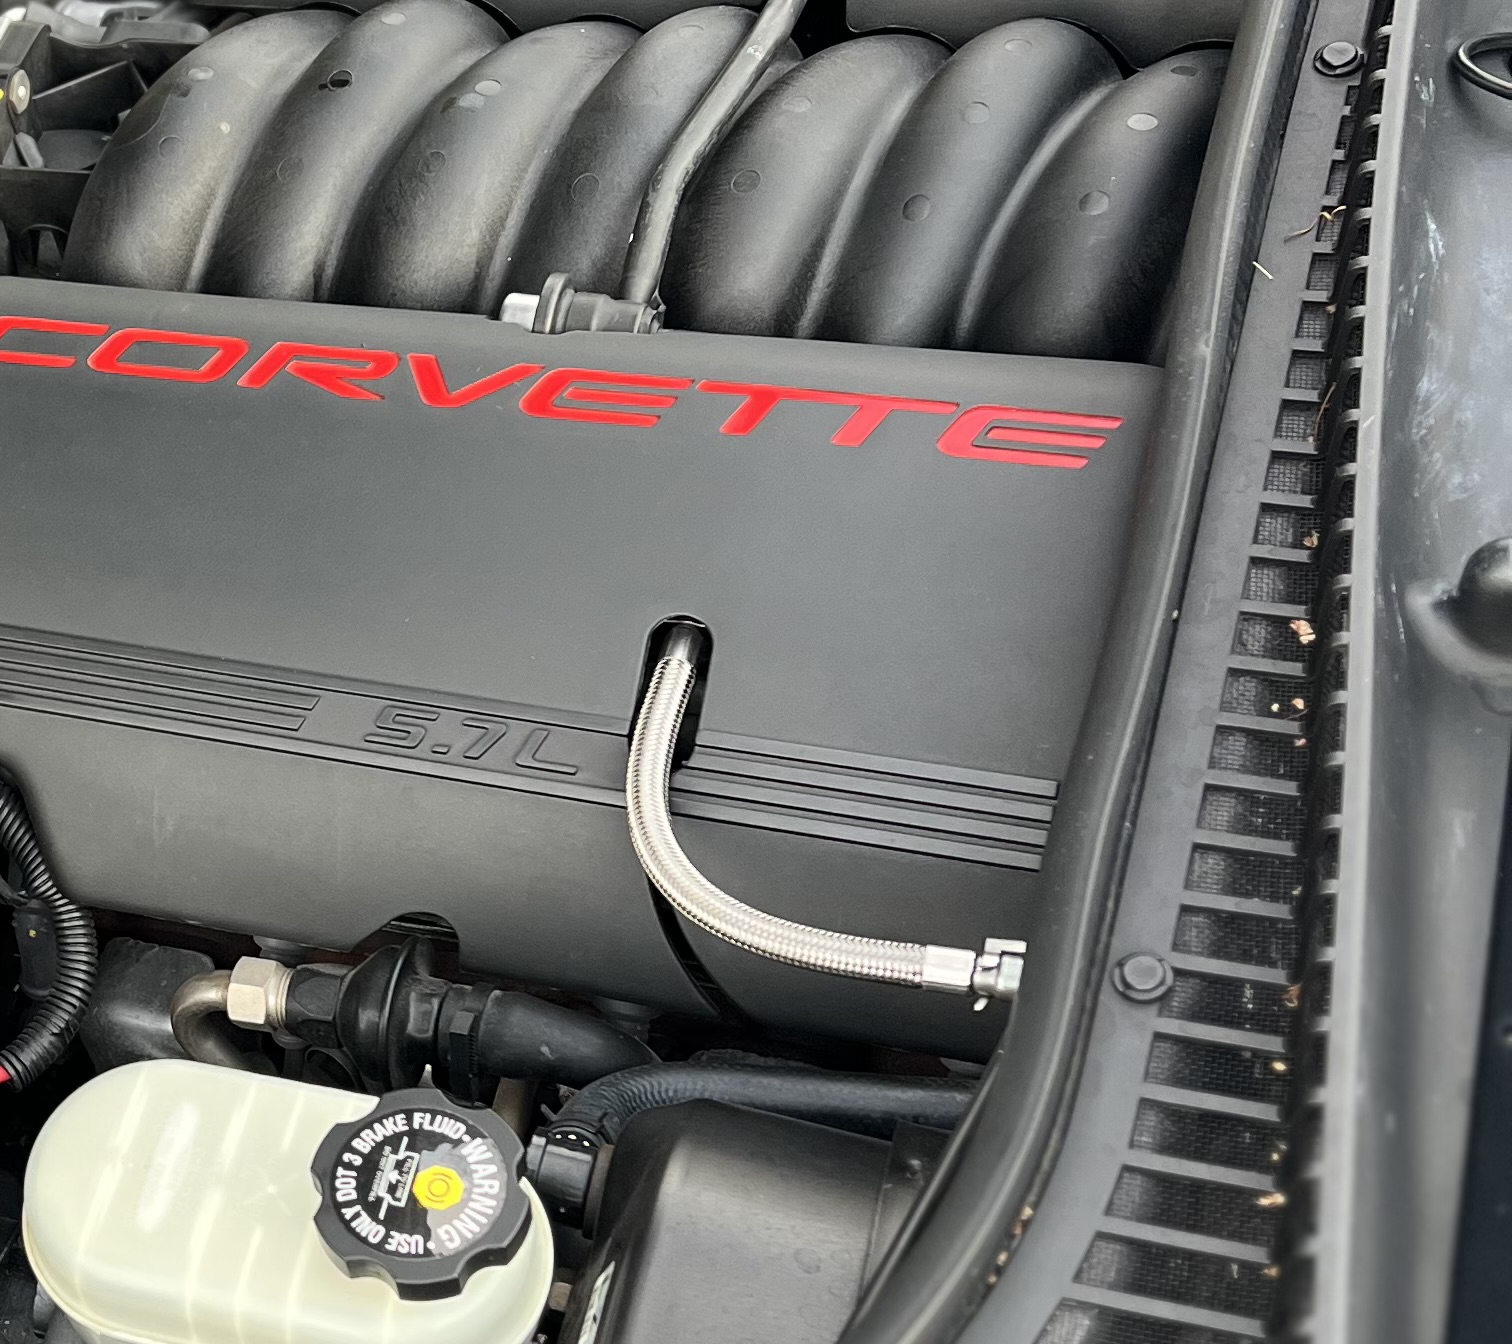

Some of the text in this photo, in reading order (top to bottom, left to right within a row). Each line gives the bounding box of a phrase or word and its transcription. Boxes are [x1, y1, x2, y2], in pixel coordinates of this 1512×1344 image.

[362, 703, 580, 777] 5.7L
[335, 1112, 501, 1255] USE ONLY DOT 3 BRAKE FLUID WARNING
